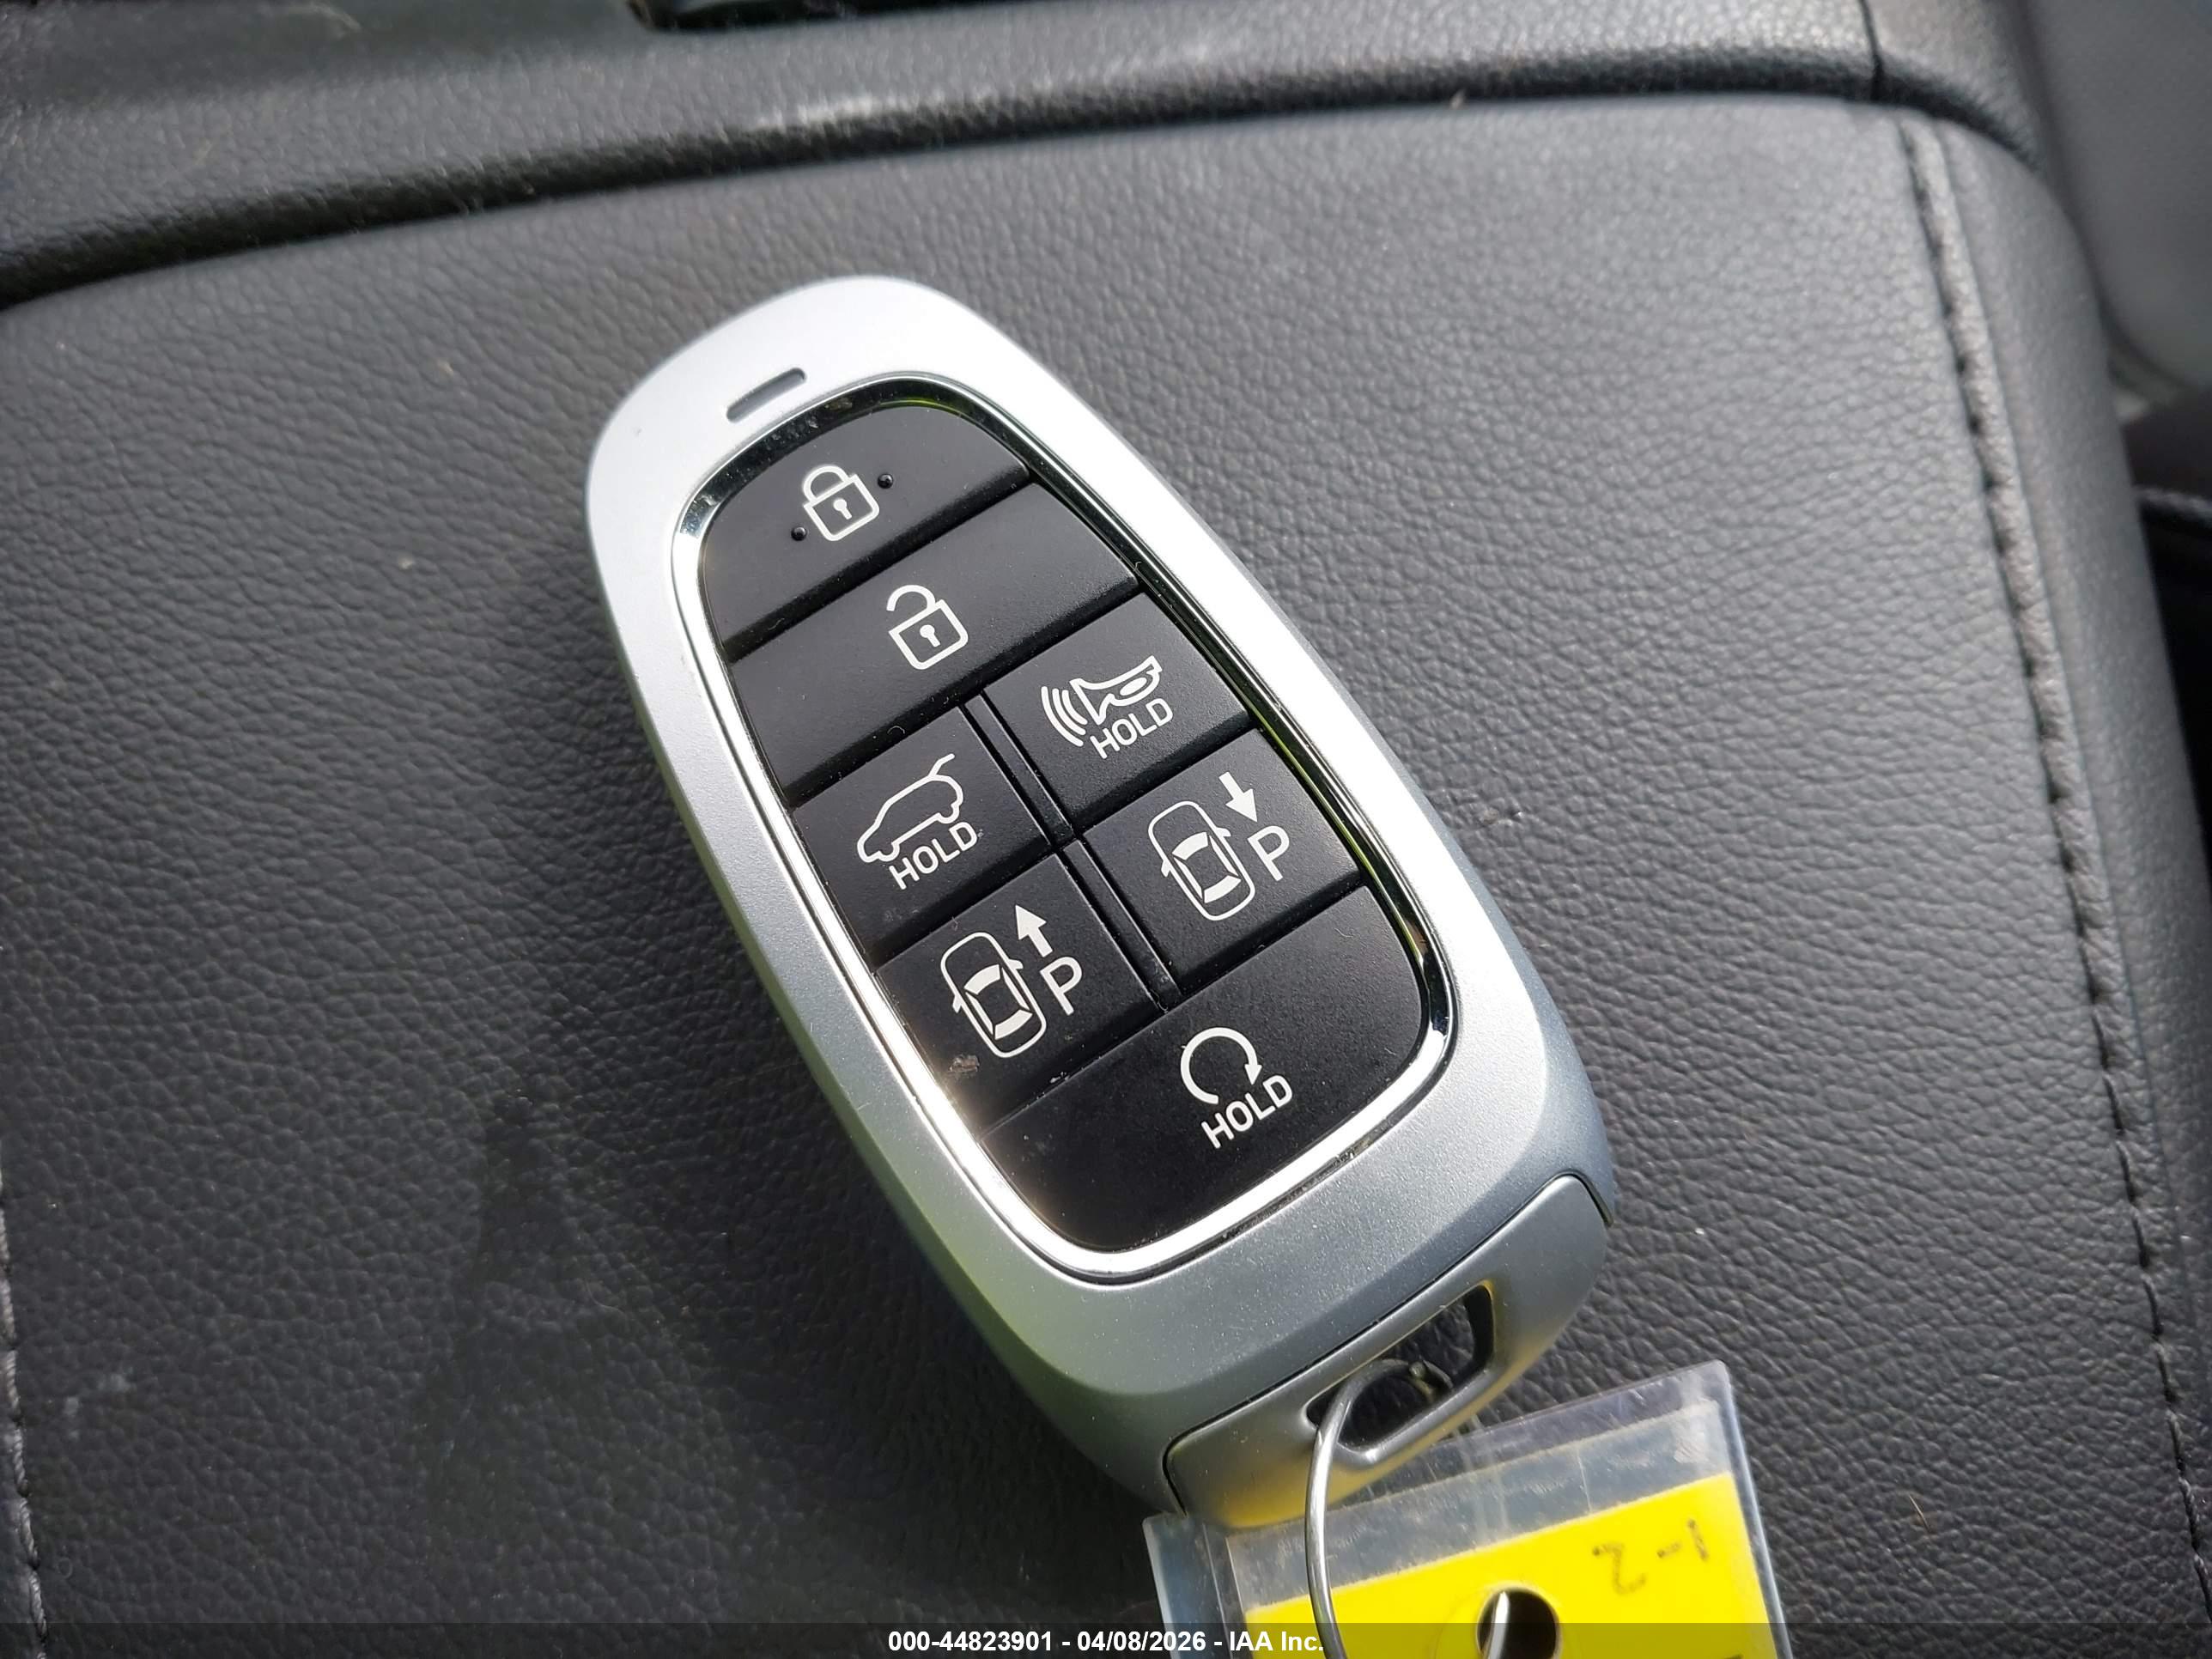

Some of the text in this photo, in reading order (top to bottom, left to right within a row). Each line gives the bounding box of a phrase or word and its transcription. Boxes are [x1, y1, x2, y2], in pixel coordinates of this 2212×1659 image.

[1090, 696, 1174, 759] HOLD
[889, 821, 978, 890] HOLD
[1247, 825, 1291, 882] P
[1039, 956, 1084, 1016] P
[1200, 1073, 1294, 1149] HOLD
